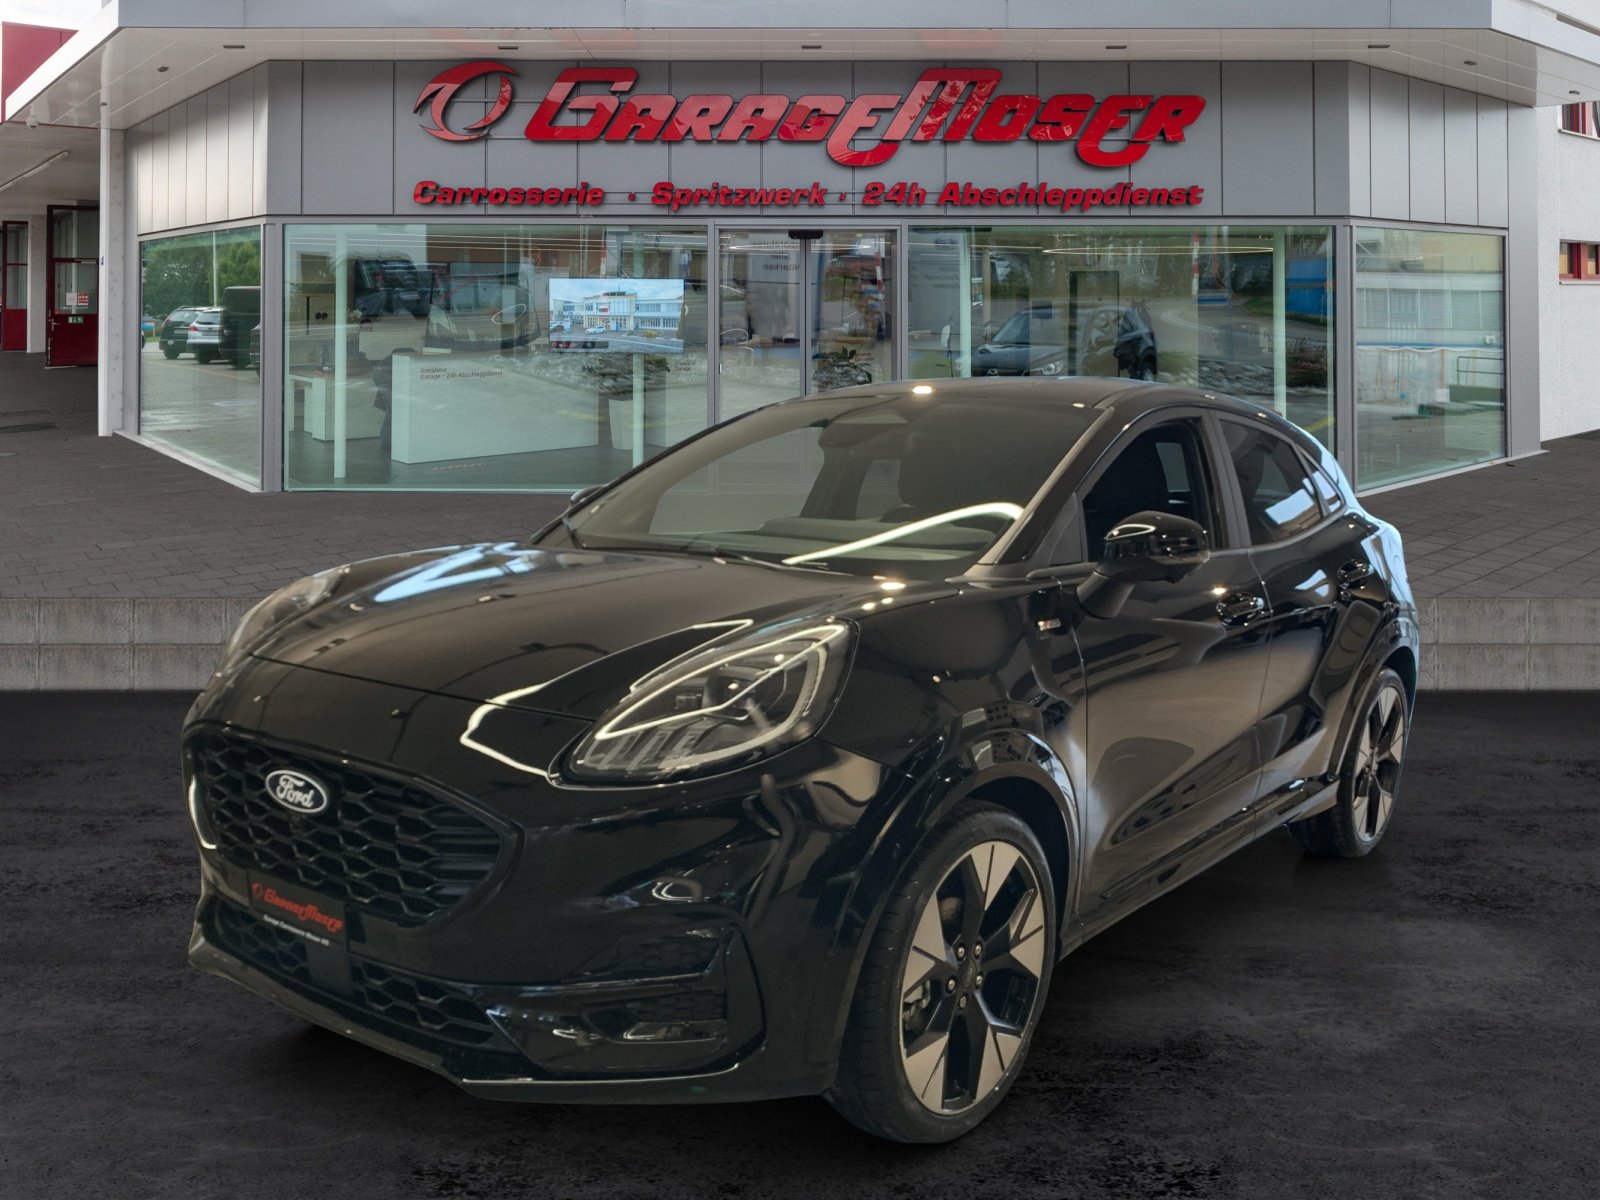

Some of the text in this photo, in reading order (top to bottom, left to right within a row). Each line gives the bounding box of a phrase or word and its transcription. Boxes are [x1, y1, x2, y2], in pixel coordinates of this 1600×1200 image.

[413, 181, 1204, 211] Carrosserie Spritzwerk 24h Abschleppdienst
[276, 774, 315, 808] Ford
